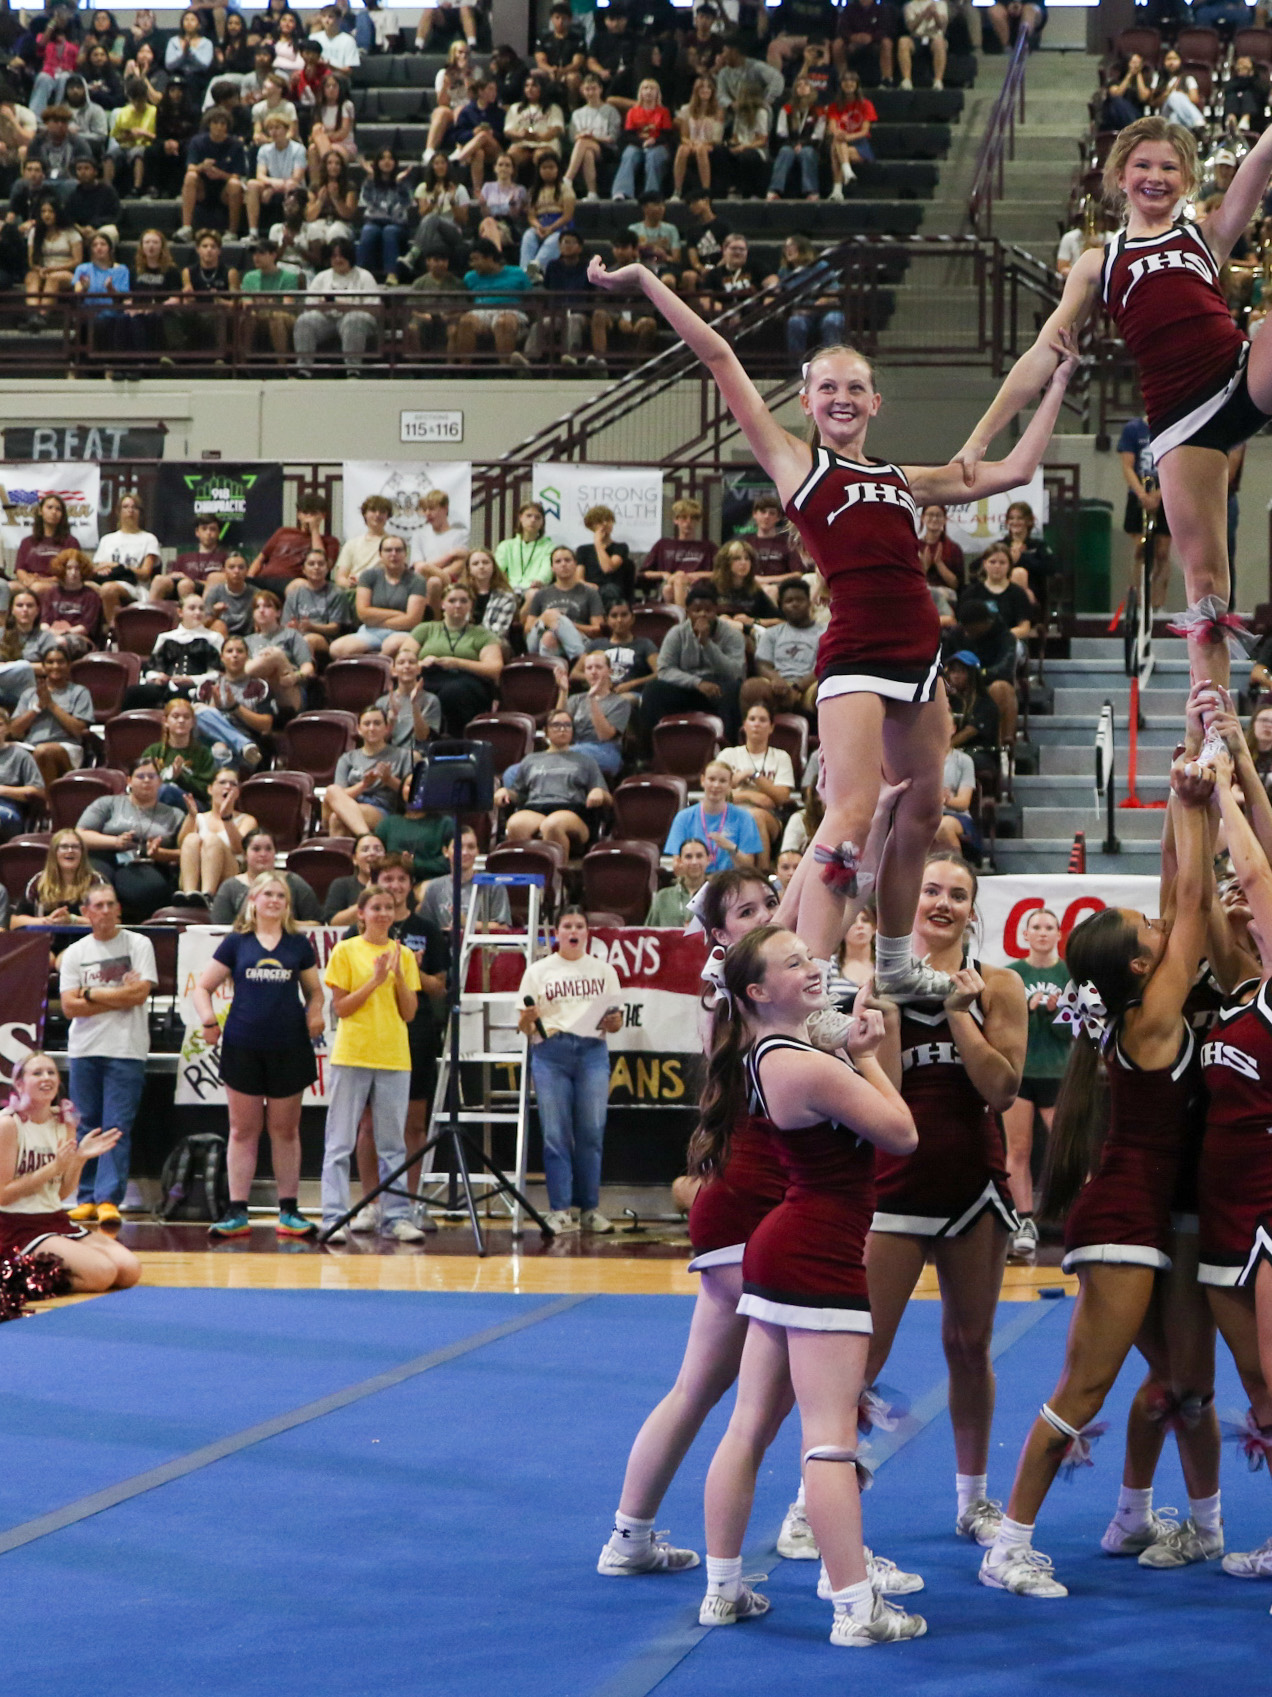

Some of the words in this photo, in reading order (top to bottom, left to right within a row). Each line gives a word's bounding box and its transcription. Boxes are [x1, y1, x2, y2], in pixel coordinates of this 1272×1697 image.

[1122, 250, 1213, 308] JHS
[404, 423, 427, 436] 115
[436, 422, 459, 437] 116
[578, 485, 659, 502] STRONG
[827, 482, 917, 526] JHS
[577, 502, 658, 520] WALTH
[545, 977, 606, 1002] GAMEDAY
[1201, 1041, 1261, 1081] HS
